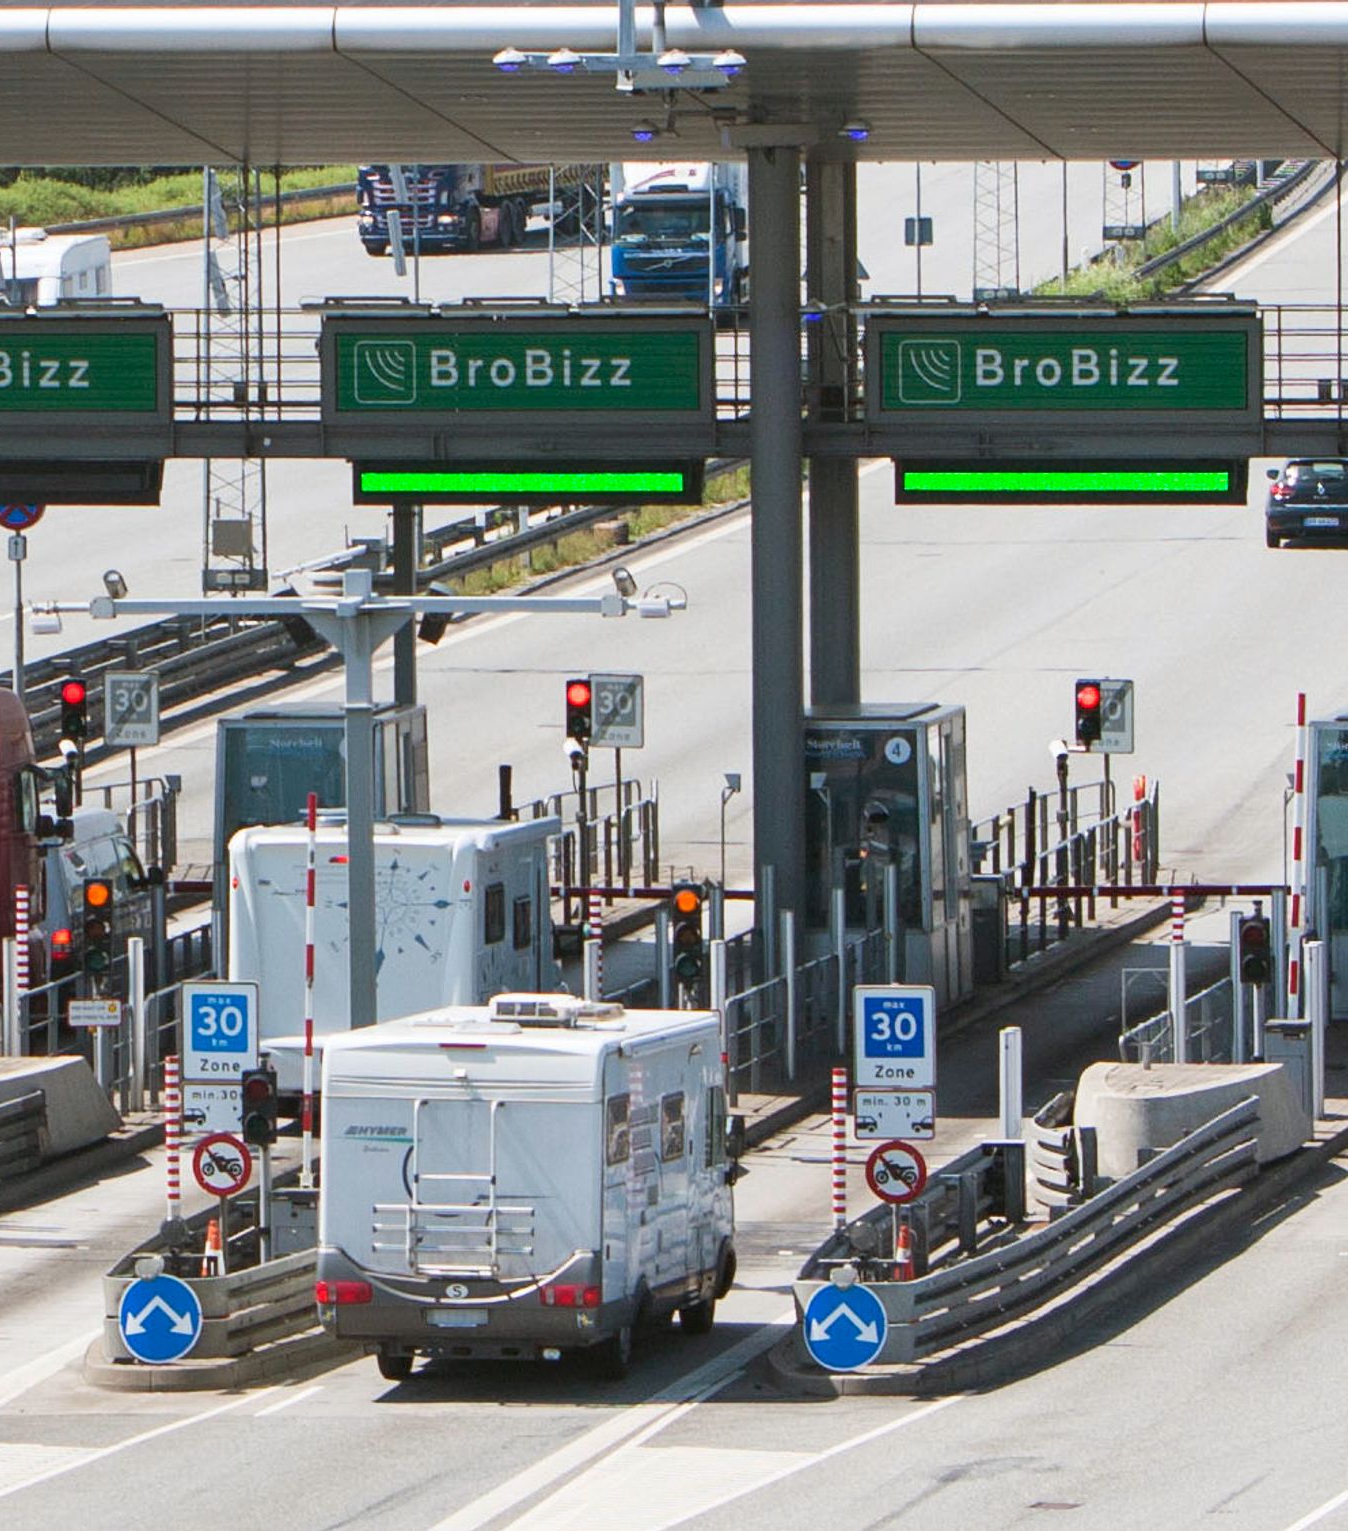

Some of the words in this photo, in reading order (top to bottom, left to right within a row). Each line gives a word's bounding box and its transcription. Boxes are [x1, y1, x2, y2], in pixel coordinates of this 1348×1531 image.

[430, 350, 632, 386] BroBizz
[975, 349, 1179, 385] BroBizz
[115, 689, 148, 711] 30
[599, 691, 632, 714] 30
[892, 743, 900, 757] 4
[197, 1006, 243, 1036] 30
[871, 1012, 917, 1041] 30
[211, 1037, 229, 1046] km
[886, 1043, 902, 1052] km
[200, 1058, 241, 1072] Zone
[875, 1066, 915, 1078] Zone
[894, 1096, 911, 1106] 30
[917, 1098, 926, 1106] m
[357, 1126, 407, 1136] HYMER
